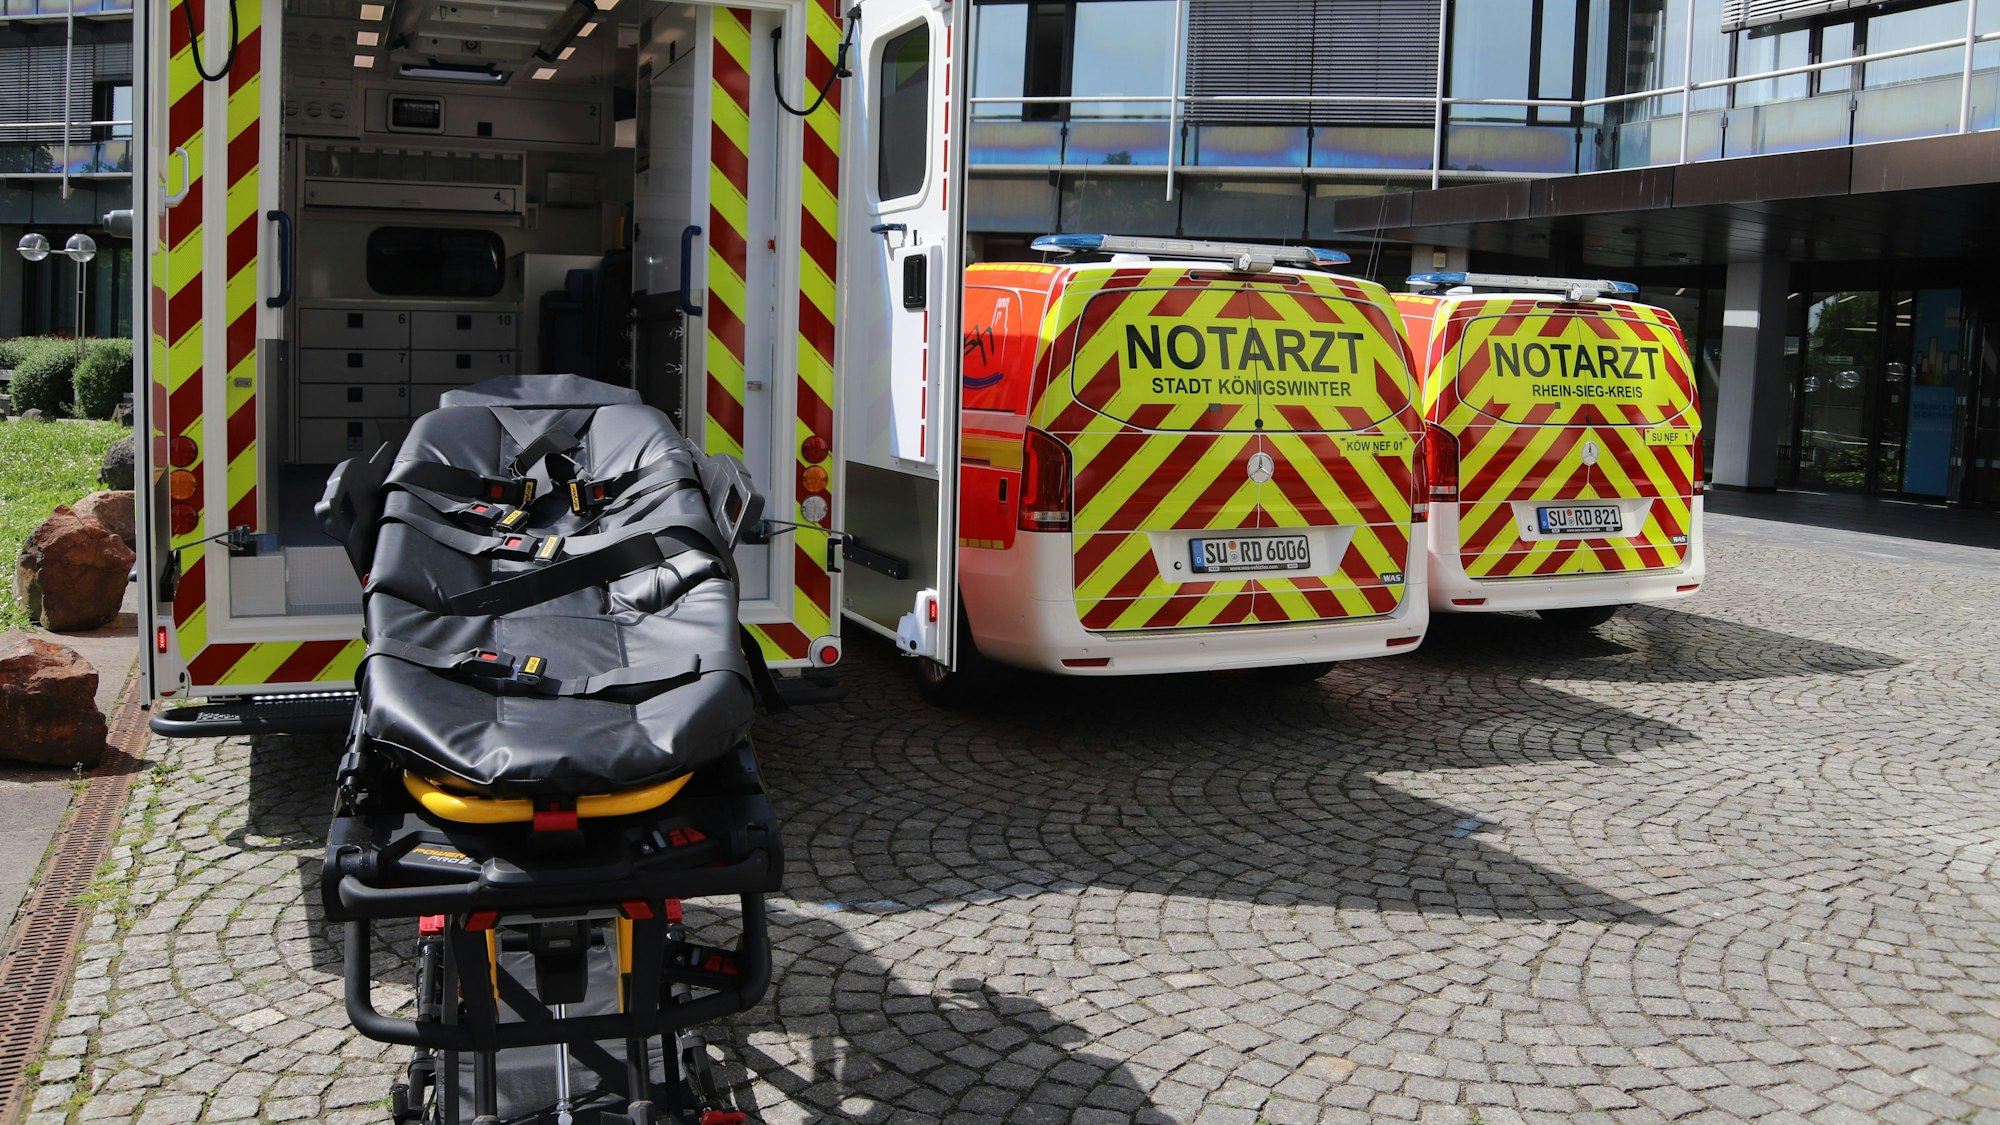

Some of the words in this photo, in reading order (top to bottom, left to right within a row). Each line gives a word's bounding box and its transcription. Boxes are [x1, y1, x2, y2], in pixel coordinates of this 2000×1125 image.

[589, 105, 597, 117] 2
[493, 191, 501, 202] 4
[398, 313, 406, 325] 6
[497, 314, 512, 326] 10
[1125, 324, 1364, 374] NOTARZT
[398, 352, 406, 364] 7
[497, 353, 511, 365] 11
[1494, 342, 1659, 380] NOTARZT
[398, 386, 406, 398] 8
[1152, 377, 1213, 395] STADT
[1218, 375, 1352, 397] KÖNIGSWINTER
[1532, 384, 1643, 399] RHEIN-SIEG-KREIS
[1651, 432, 1663, 442] SU
[1664, 432, 1679, 442] NEF
[1346, 439, 1370, 452] KÖW
[1372, 440, 1391, 451] NEF
[1393, 440, 1403, 451] 01
[1548, 510, 1567, 527] SU
[1574, 509, 1593, 526] RD
[1595, 509, 1619, 525] 821
[1205, 542, 1228, 564] SU
[1240, 541, 1263, 562] RD
[1266, 540, 1307, 561] 6006
[1196, 556, 1202, 564] D
[1383, 574, 1401, 582] WAS
